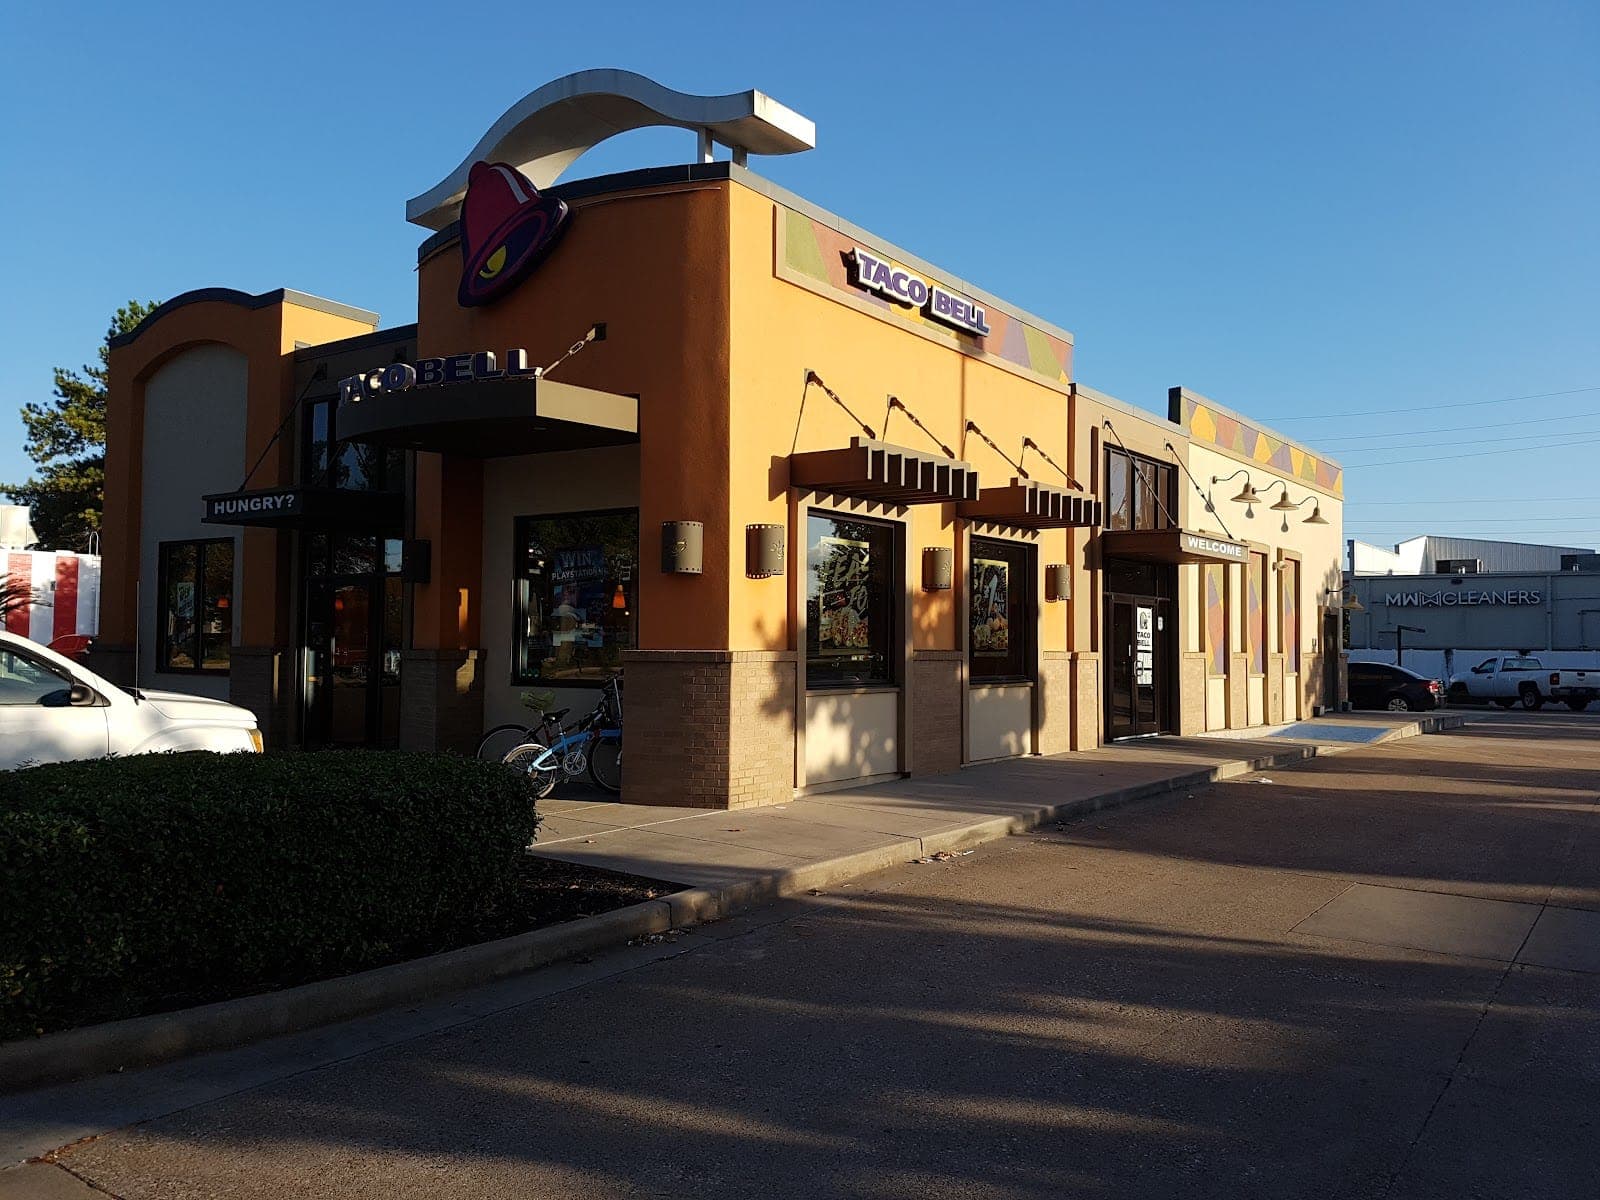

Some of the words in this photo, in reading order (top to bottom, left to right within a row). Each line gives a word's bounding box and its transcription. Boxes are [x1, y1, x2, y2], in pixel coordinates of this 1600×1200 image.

[856, 250, 929, 306] TACO
[933, 287, 990, 334] BELL
[338, 362, 417, 402] TACO
[417, 348, 544, 385] BELL
[213, 493, 295, 515] HUNGRY?
[1187, 536, 1242, 557] WELCOME
[559, 550, 592, 568] WIN
[1385, 591, 1418, 607] MW
[1441, 590, 1541, 607] CLEANERS
[1137, 631, 1151, 639] TACO
